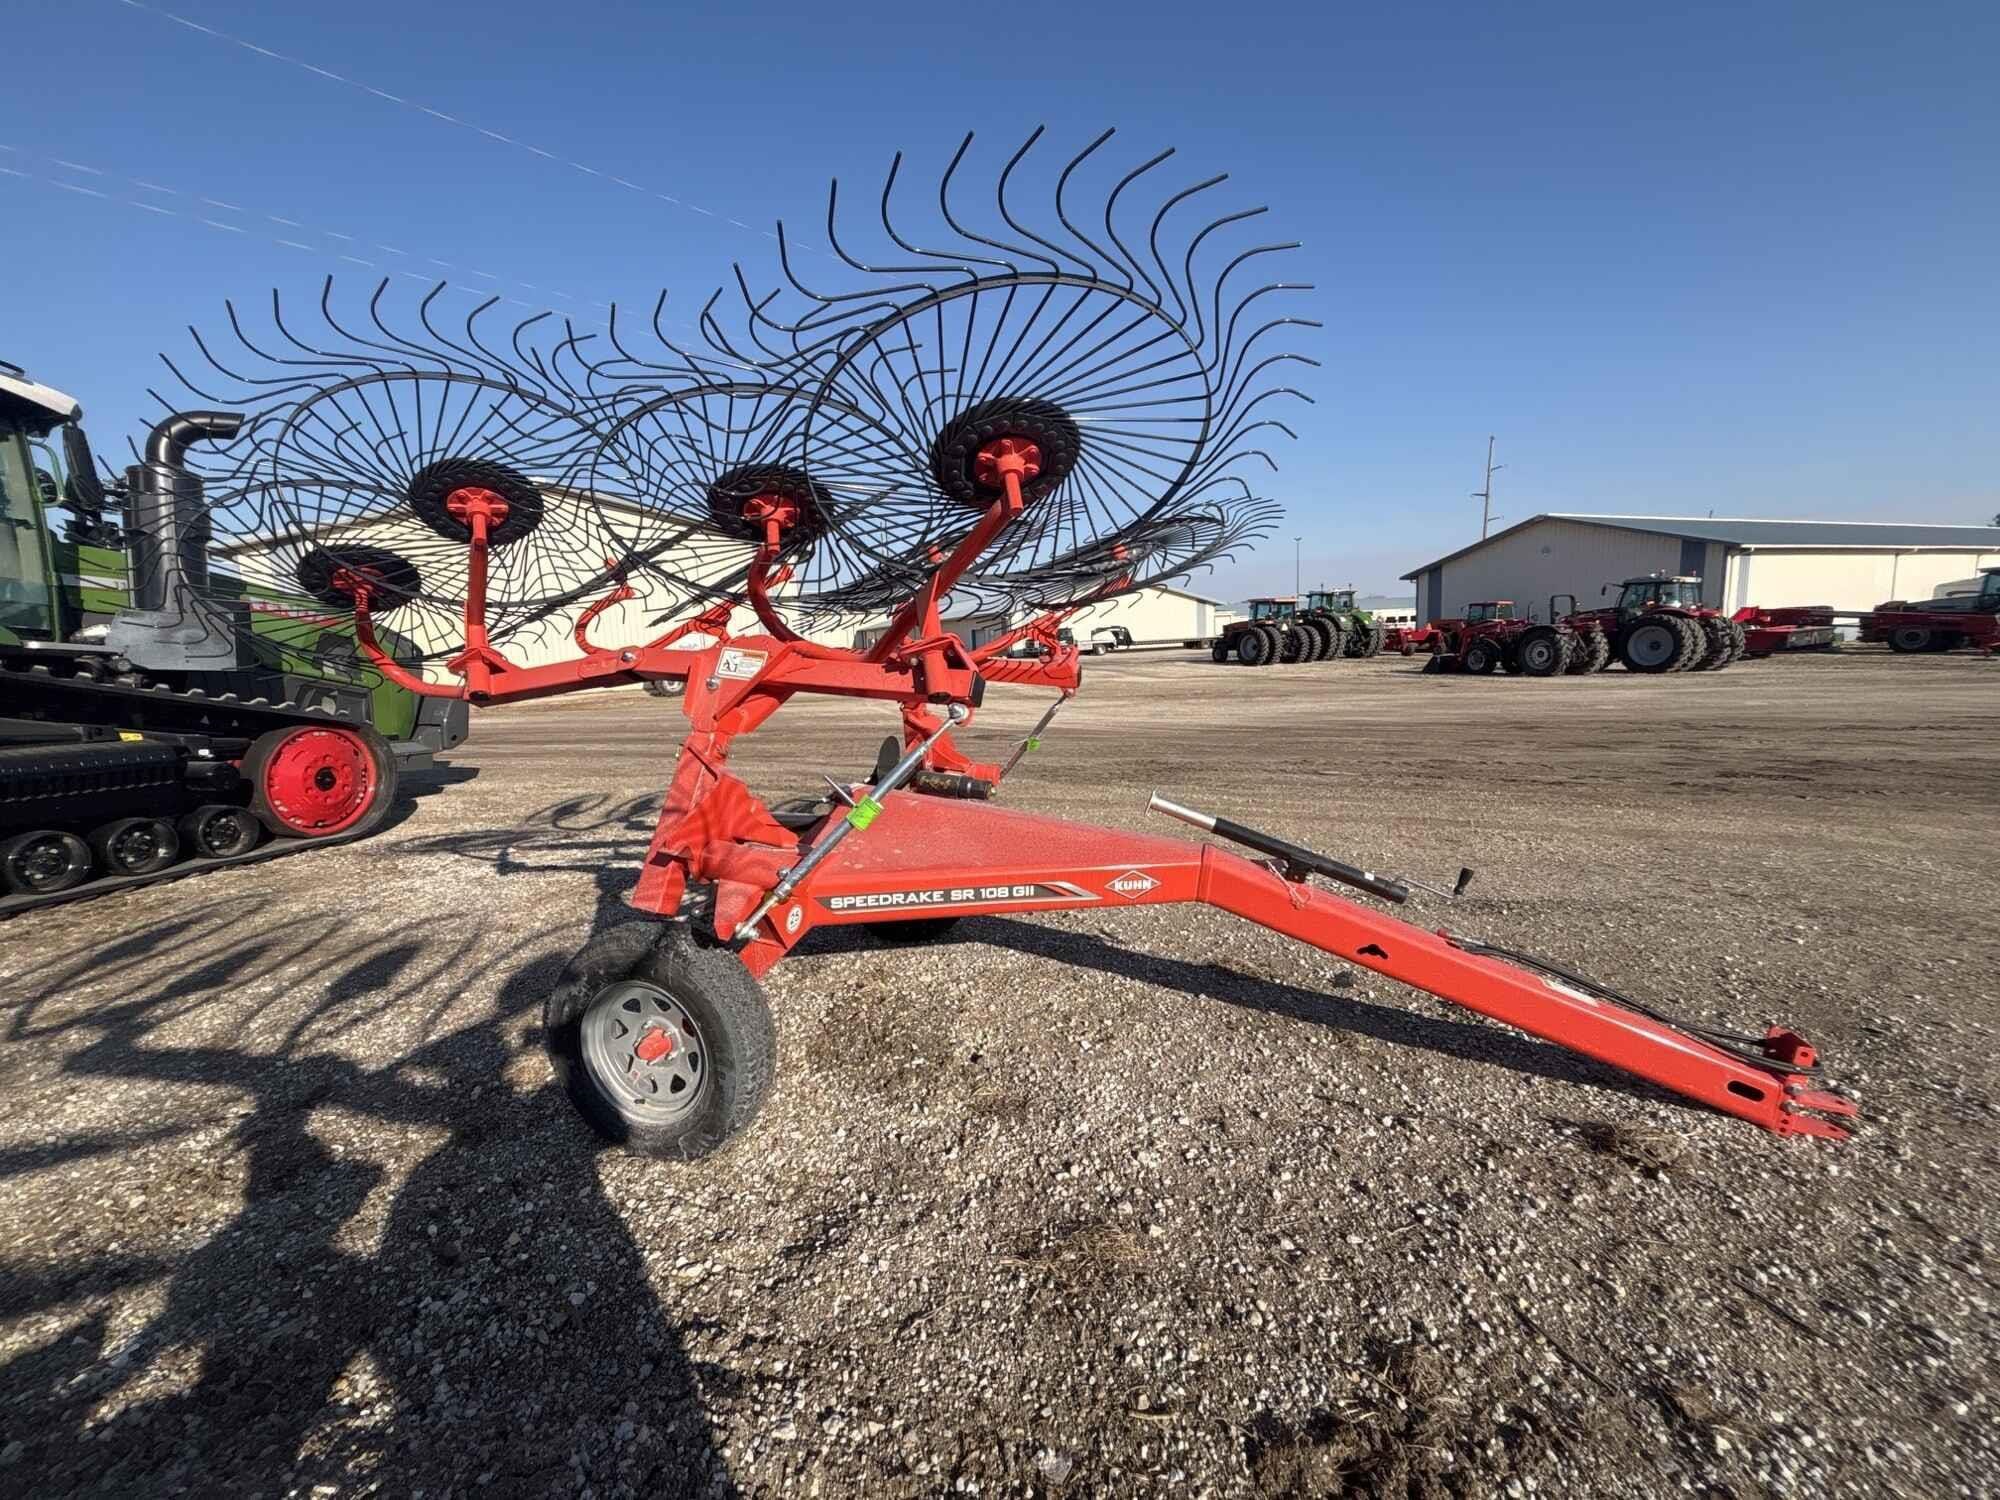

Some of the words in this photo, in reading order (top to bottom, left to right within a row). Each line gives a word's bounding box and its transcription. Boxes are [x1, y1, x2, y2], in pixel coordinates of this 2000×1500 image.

[1114, 880, 1152, 890] KUHN
[830, 890, 944, 909] SPEEDRAKE
[950, 889, 975, 901] SR
[980, 886, 1009, 899] 108
[1012, 885, 1034, 897] GII
